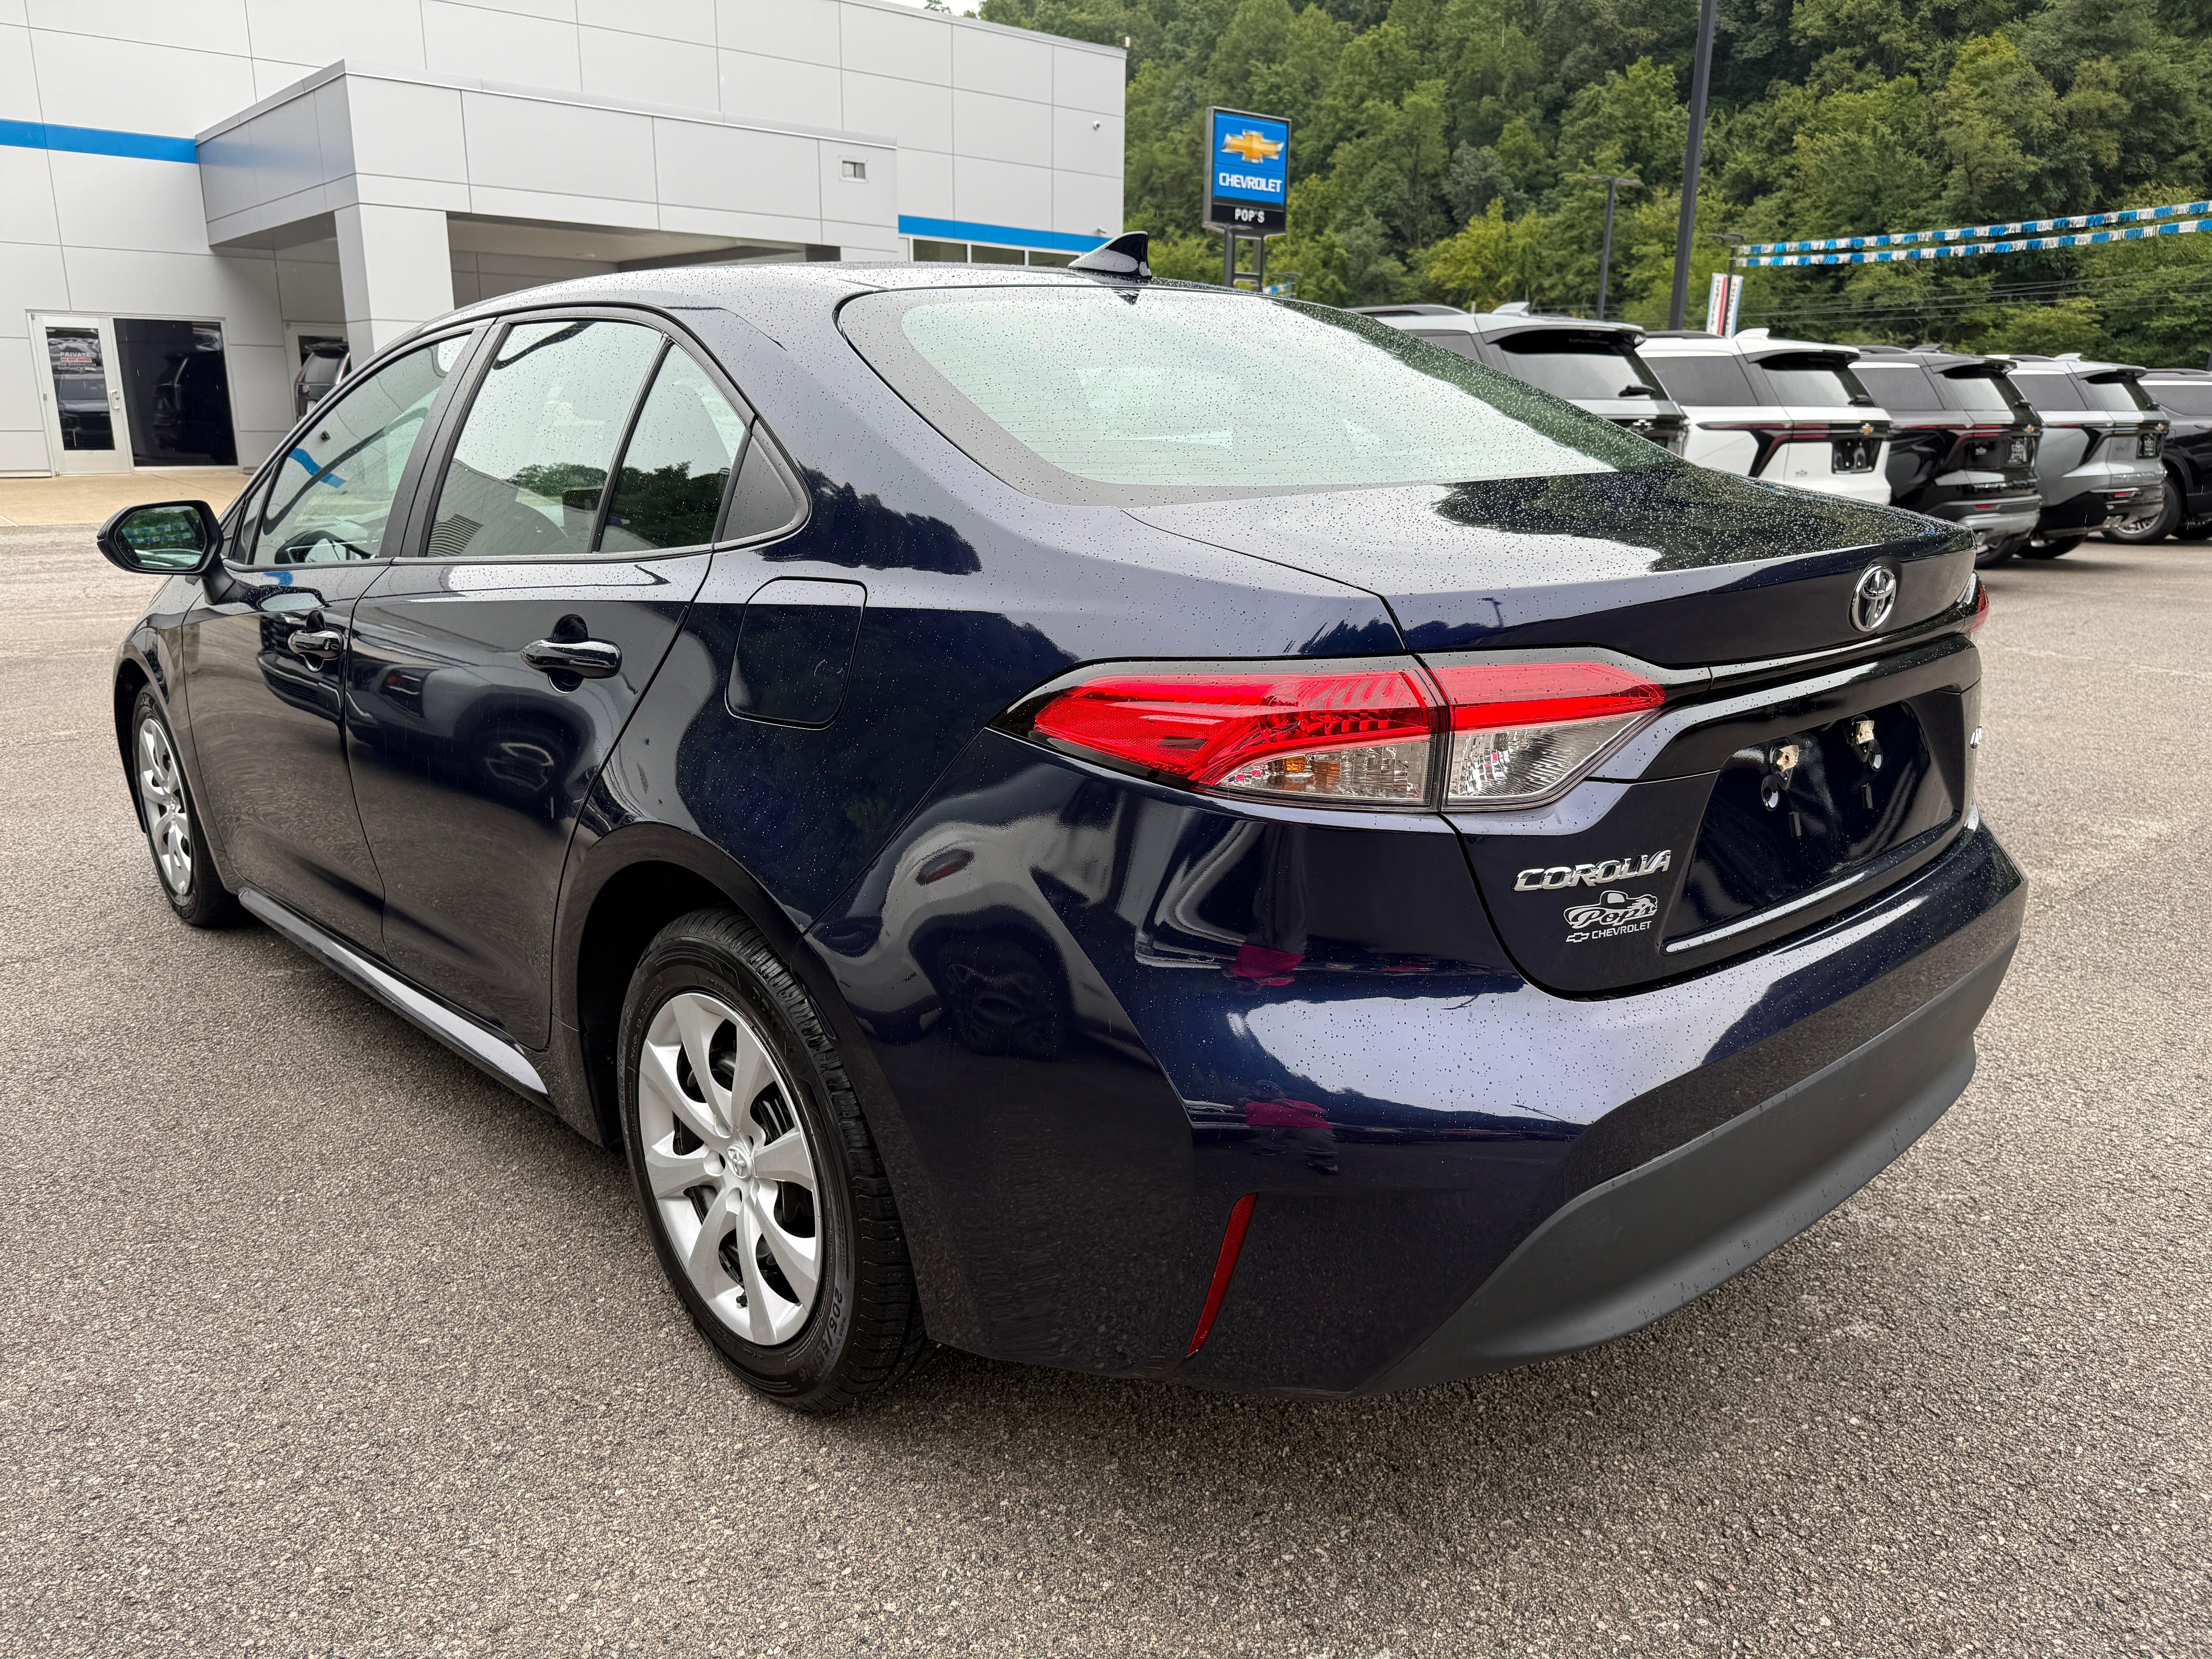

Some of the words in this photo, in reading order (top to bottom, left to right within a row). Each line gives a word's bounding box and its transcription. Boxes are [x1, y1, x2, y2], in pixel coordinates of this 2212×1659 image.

[1219, 172, 1283, 193] CHEVROLET
[1235, 207, 1265, 223] POP'S
[1511, 850, 1671, 891] COROLLA
[1592, 921, 1652, 939] CHEVROLET
